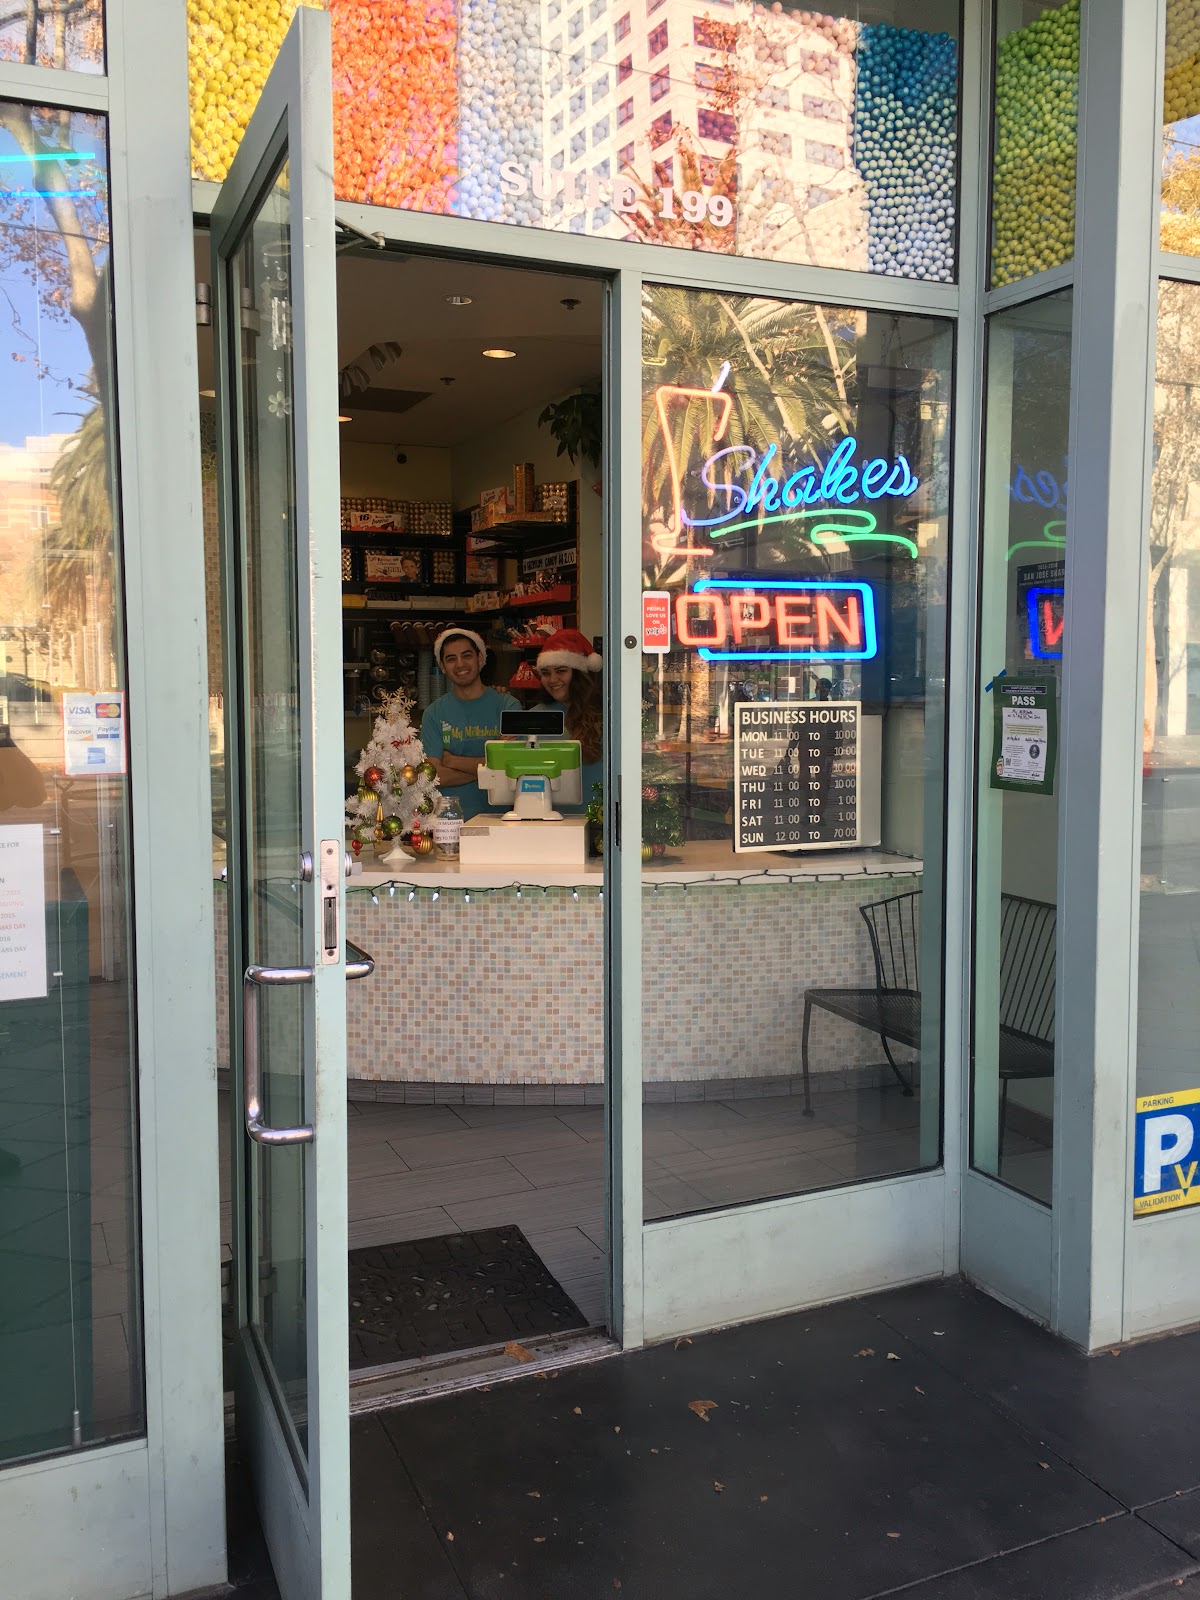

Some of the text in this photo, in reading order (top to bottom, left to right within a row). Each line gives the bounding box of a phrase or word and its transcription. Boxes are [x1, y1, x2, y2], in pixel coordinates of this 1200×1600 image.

[499, 161, 733, 227] SUITE 199
[683, 437, 919, 526] Shakes
[1024, 572, 1034, 580] SAN
[1036, 570, 1049, 579] JOSE
[676, 595, 860, 646] OPEN
[1011, 695, 1036, 706] PASS
[69, 706, 91, 715] VISA
[742, 709, 856, 725] BUSINESS HOURS
[97, 726, 120, 734] PayPal
[451, 726, 463, 741] My
[742, 731, 768, 742] MON
[808, 732, 821, 741] TO
[741, 748, 764, 759] TUE
[808, 748, 821, 757] TO
[742, 765, 767, 777] WED
[808, 765, 821, 774] TO
[741, 781, 766, 793] THU
[808, 781, 821, 791] TO
[742, 798, 762, 810] FRI
[808, 798, 821, 807] TO
[742, 815, 764, 827] SAT
[808, 814, 821, 824] TO
[742, 832, 764, 844] SUN
[808, 831, 821, 840] TO
[14, 945, 27, 953] DAY
[1142, 1097, 1174, 1108] PARKING
[1144, 1114, 1194, 1193] P
[1174, 1160, 1198, 1197] V
[1139, 1193, 1182, 1208] VALIDATION
